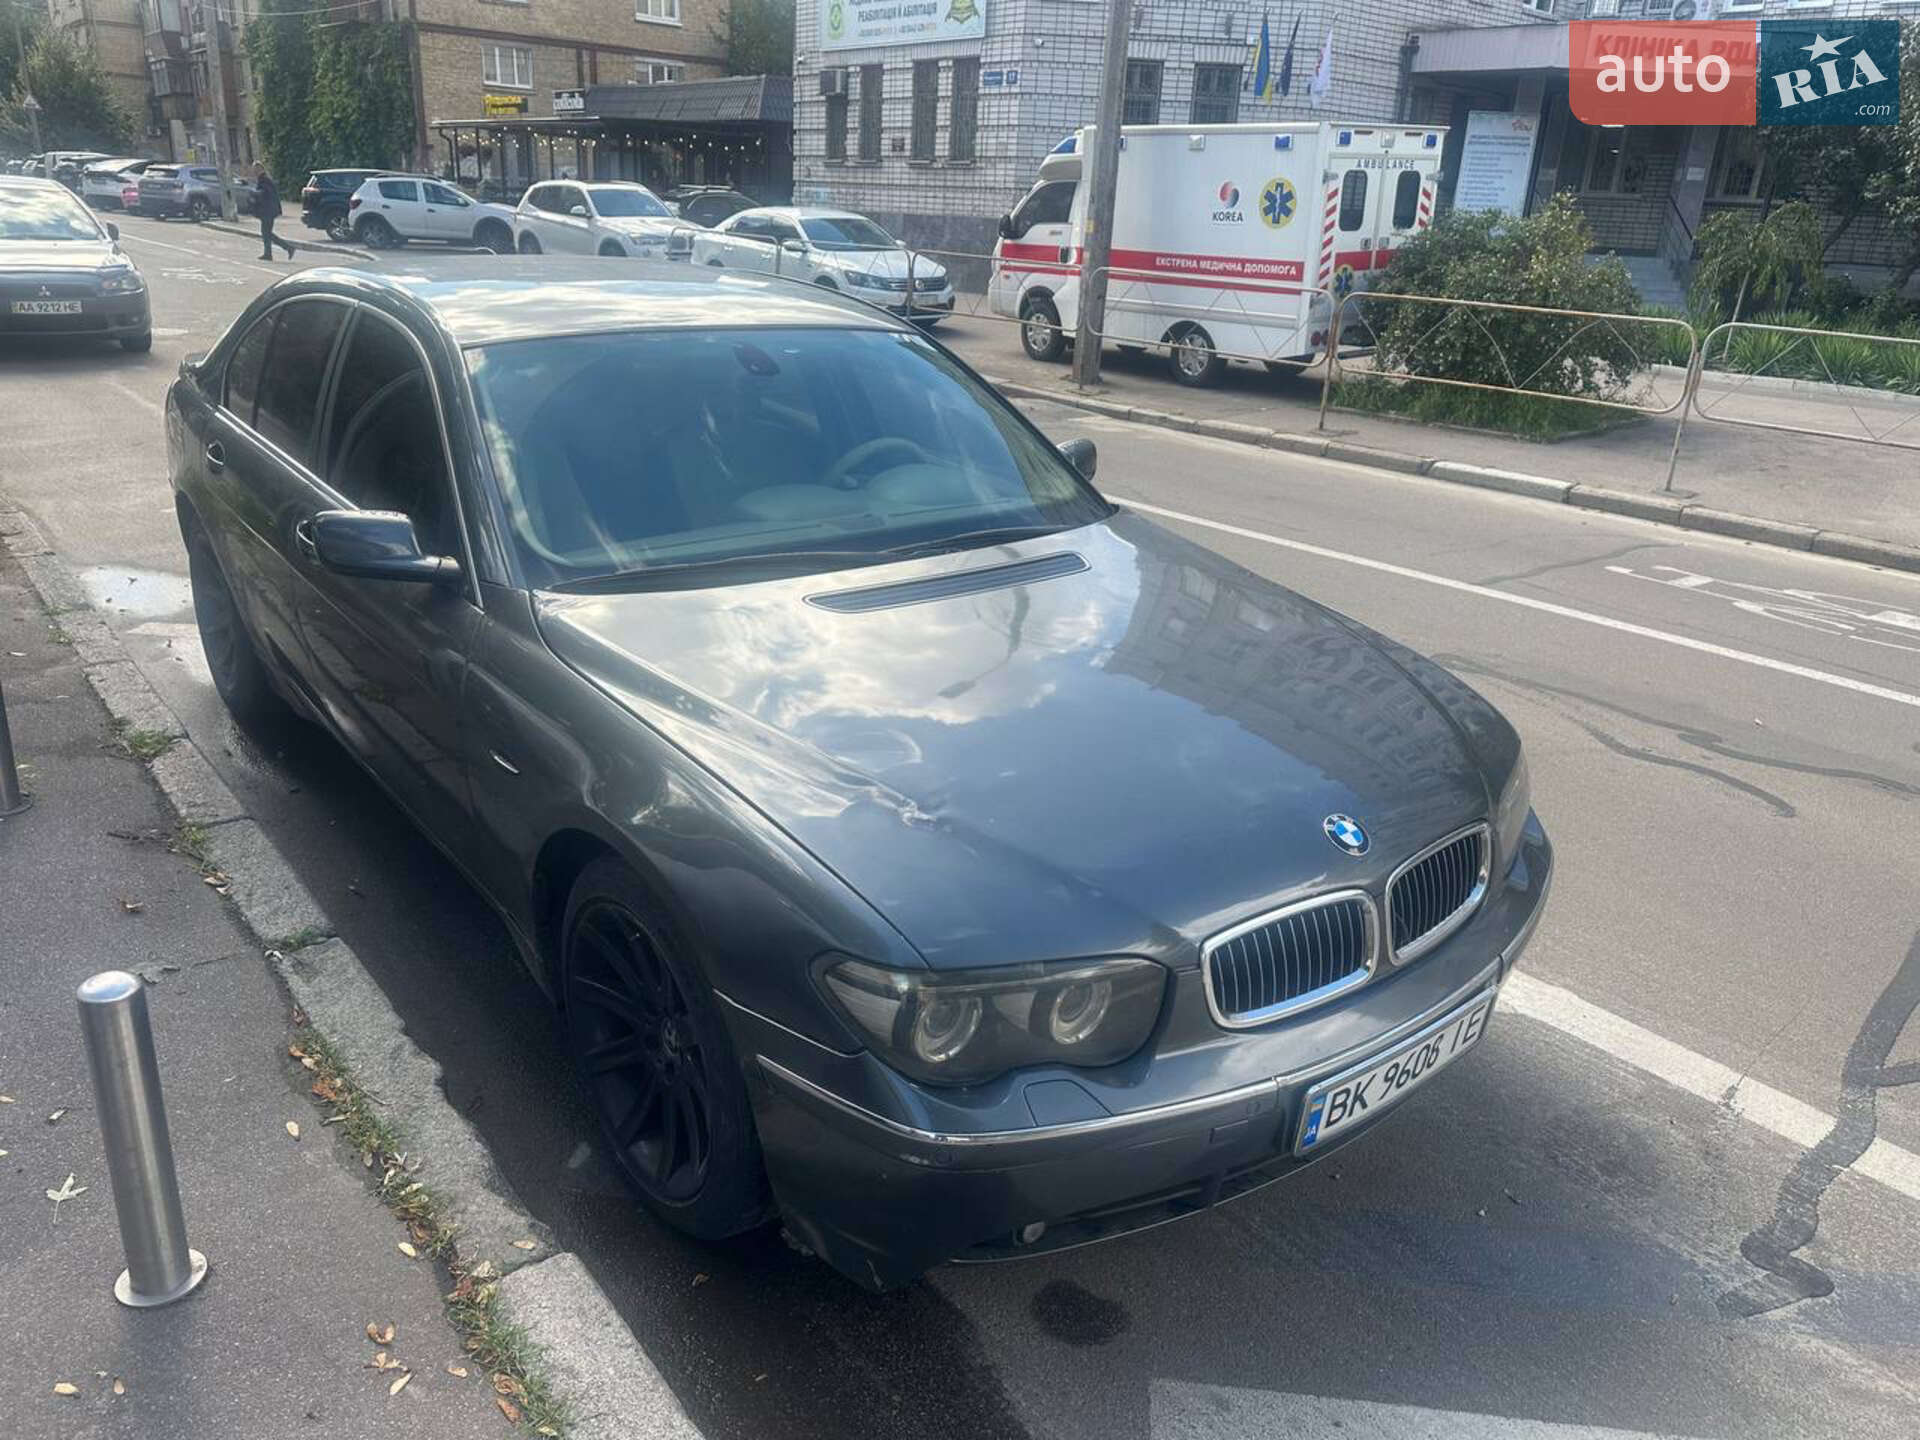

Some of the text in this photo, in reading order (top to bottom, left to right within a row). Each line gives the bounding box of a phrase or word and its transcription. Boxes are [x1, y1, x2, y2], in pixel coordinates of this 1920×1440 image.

[1355, 159, 1415, 169] AMBULANCE
[1212, 211, 1243, 222] KOREA
[1155, 256, 1297, 276] ЕКСТРЕНА МЕДИЧНА ДОПОМОГА
[18, 302, 34, 312] AA
[1324, 1004, 1486, 1128] BK 9606 IE
